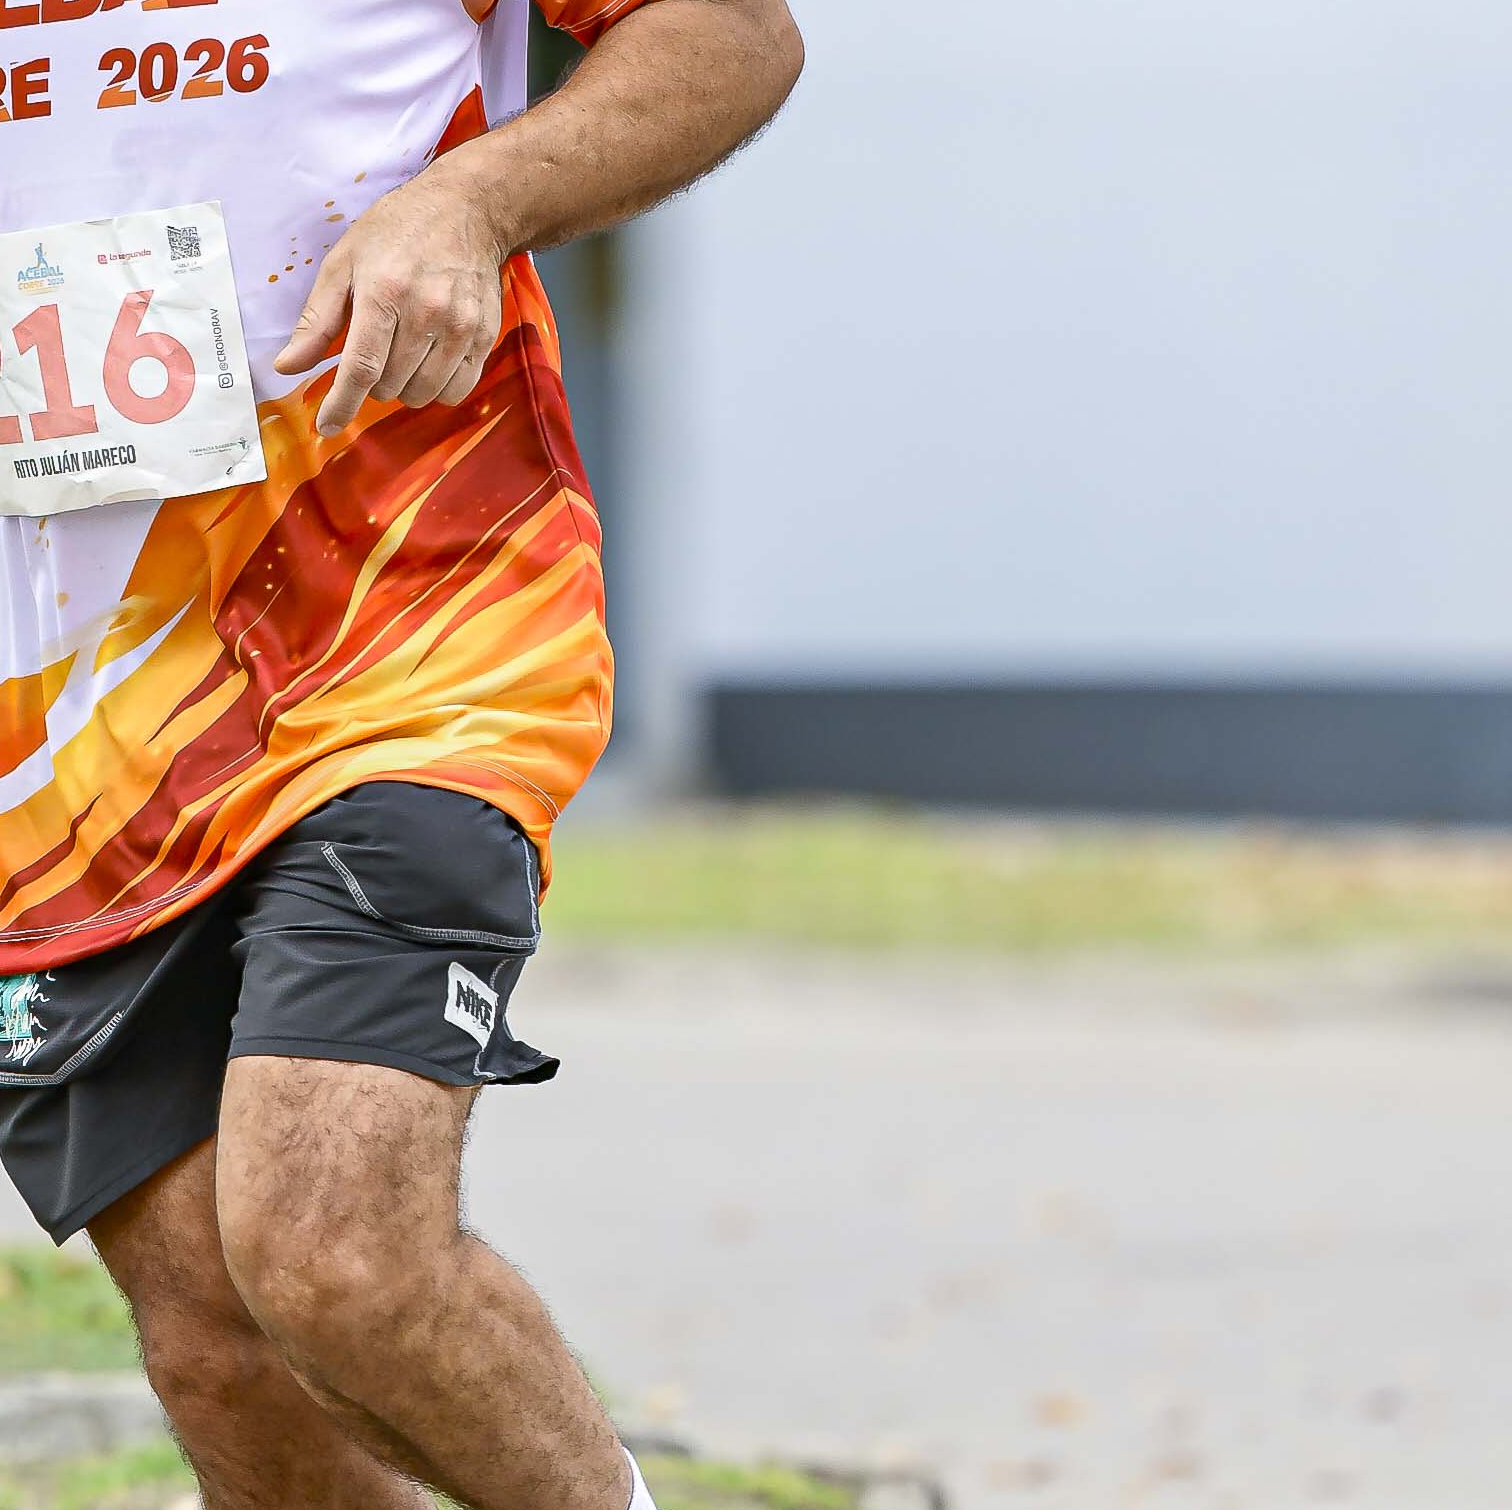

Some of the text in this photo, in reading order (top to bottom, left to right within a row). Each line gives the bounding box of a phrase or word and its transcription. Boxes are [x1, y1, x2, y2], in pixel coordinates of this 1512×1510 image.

[97, 33, 270, 109] 2026
[17, 265, 64, 282] ACEBAL
[210, 307, 229, 371] @CRONORAV
[13, 444, 137, 479] RITO JULIÁN MARECO
[455, 979, 493, 1032] NIKE
